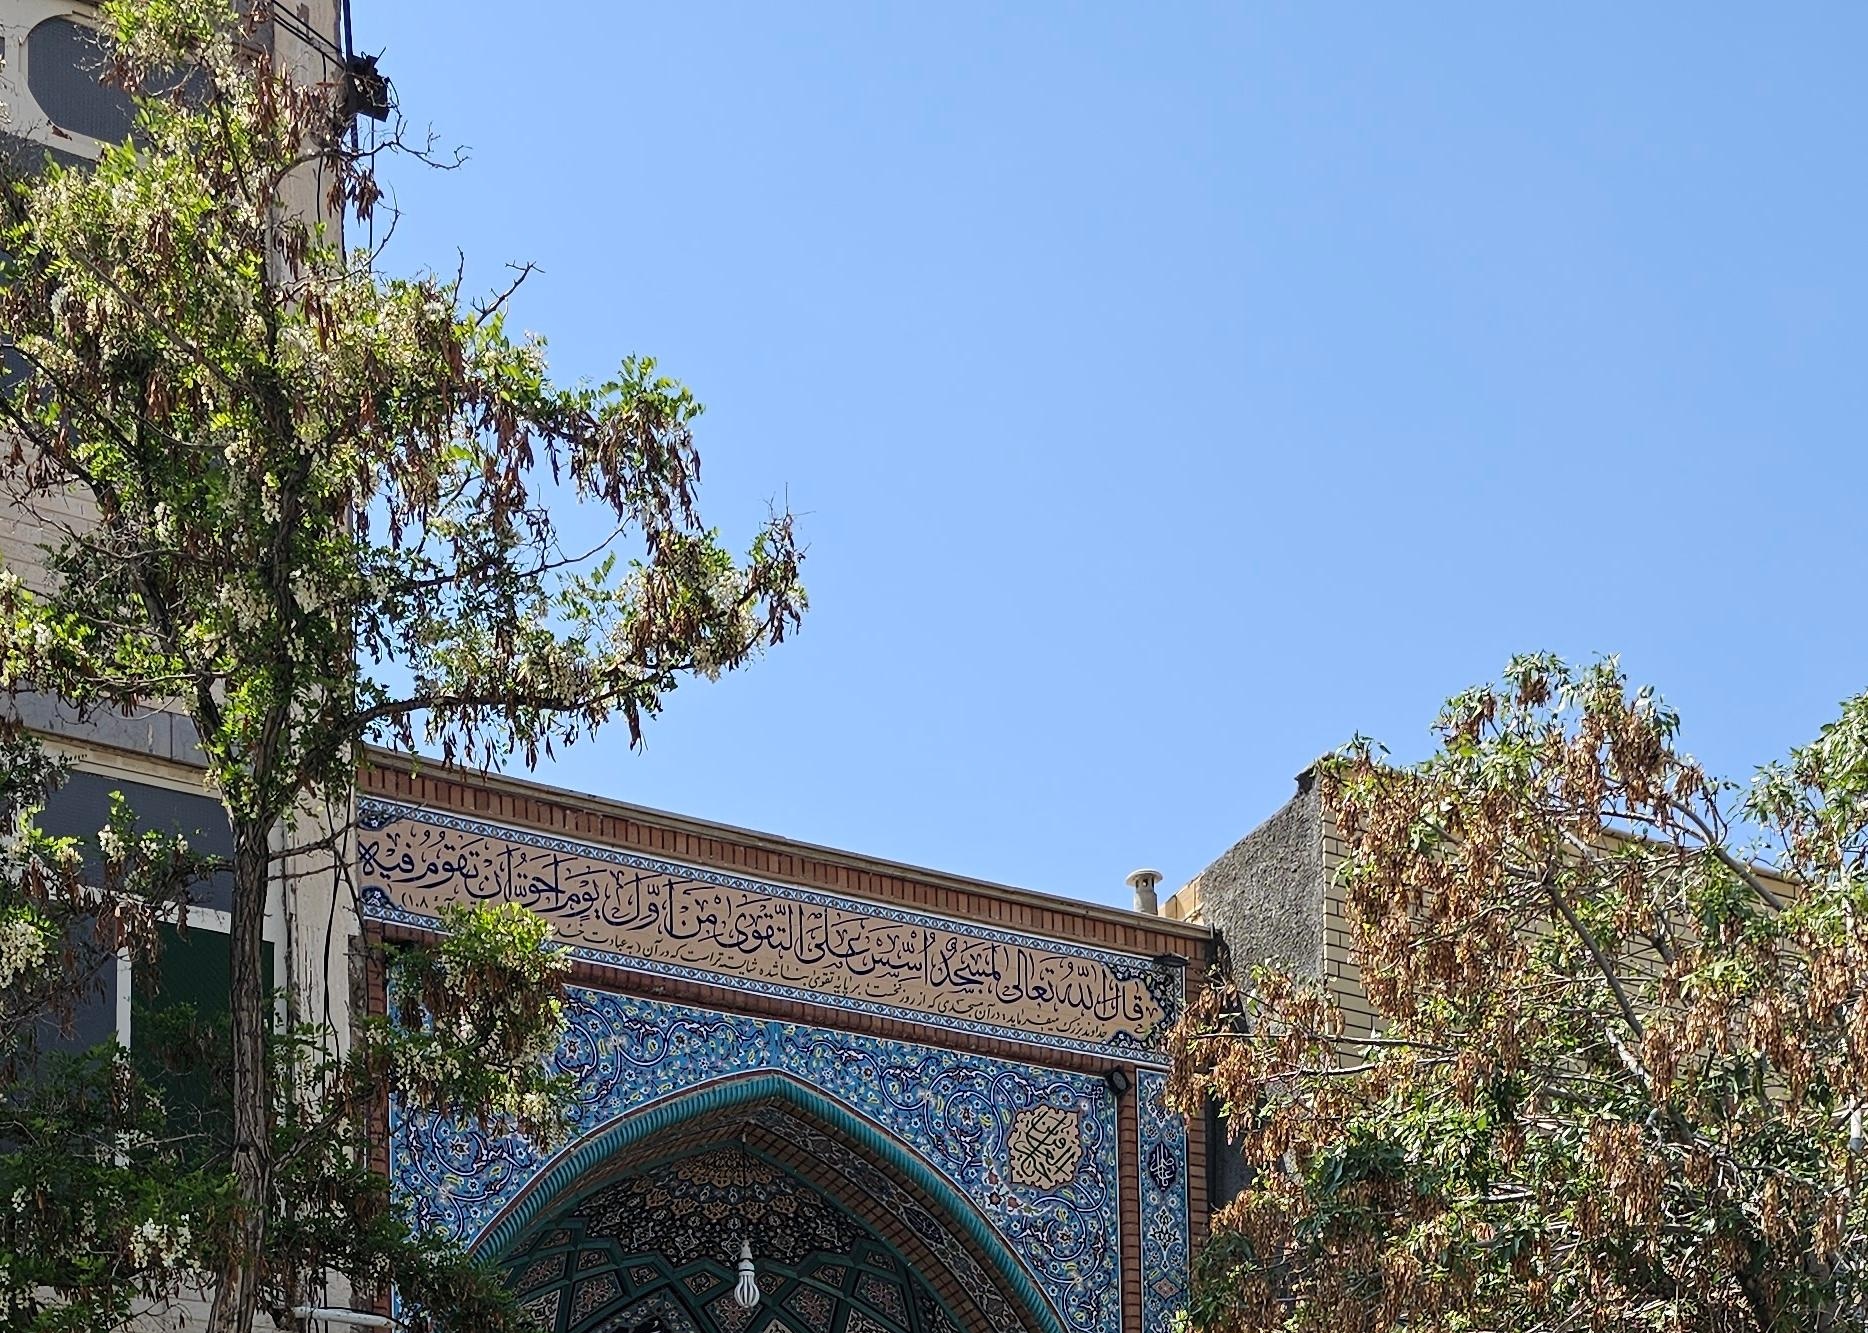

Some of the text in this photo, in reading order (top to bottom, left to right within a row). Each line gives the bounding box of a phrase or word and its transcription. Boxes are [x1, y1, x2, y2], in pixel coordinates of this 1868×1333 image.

[642, 938, 664, 958] آن
[669, 942, 688, 959] که
[759, 961, 779, 978] شده
[849, 983, 861, 996] بر
[899, 989, 916, 1006] روز
[927, 992, 945, 1009] که
